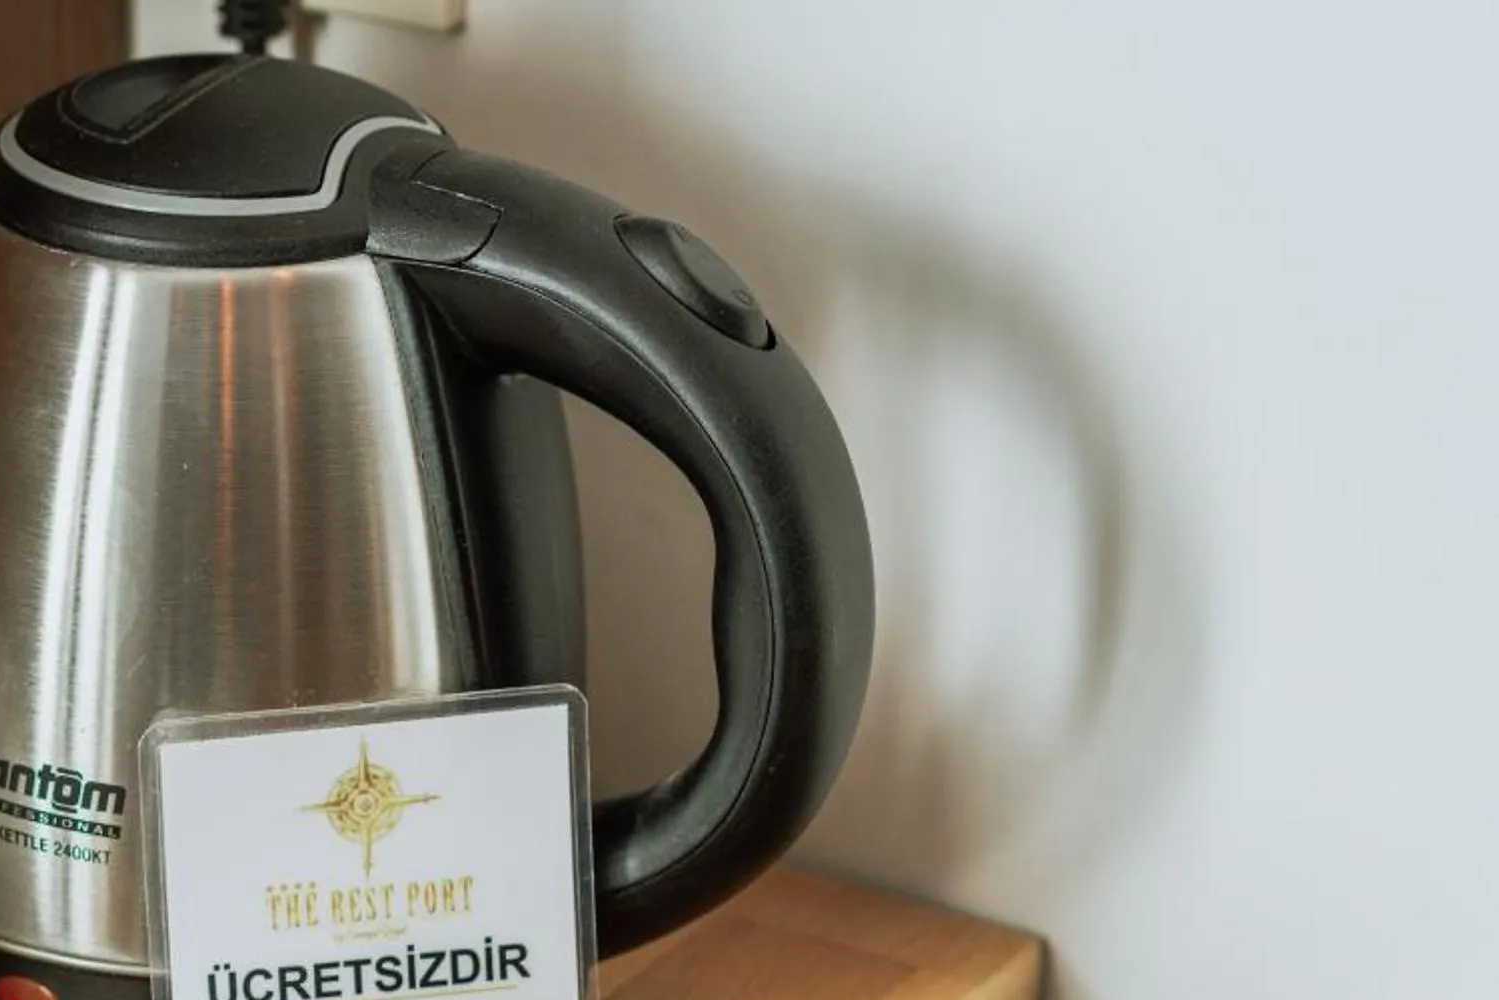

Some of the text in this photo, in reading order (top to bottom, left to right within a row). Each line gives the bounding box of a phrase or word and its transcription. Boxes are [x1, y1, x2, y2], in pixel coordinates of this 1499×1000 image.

[53, 841, 111, 865] 2400KT
[267, 875, 474, 929] THE REST PORT
